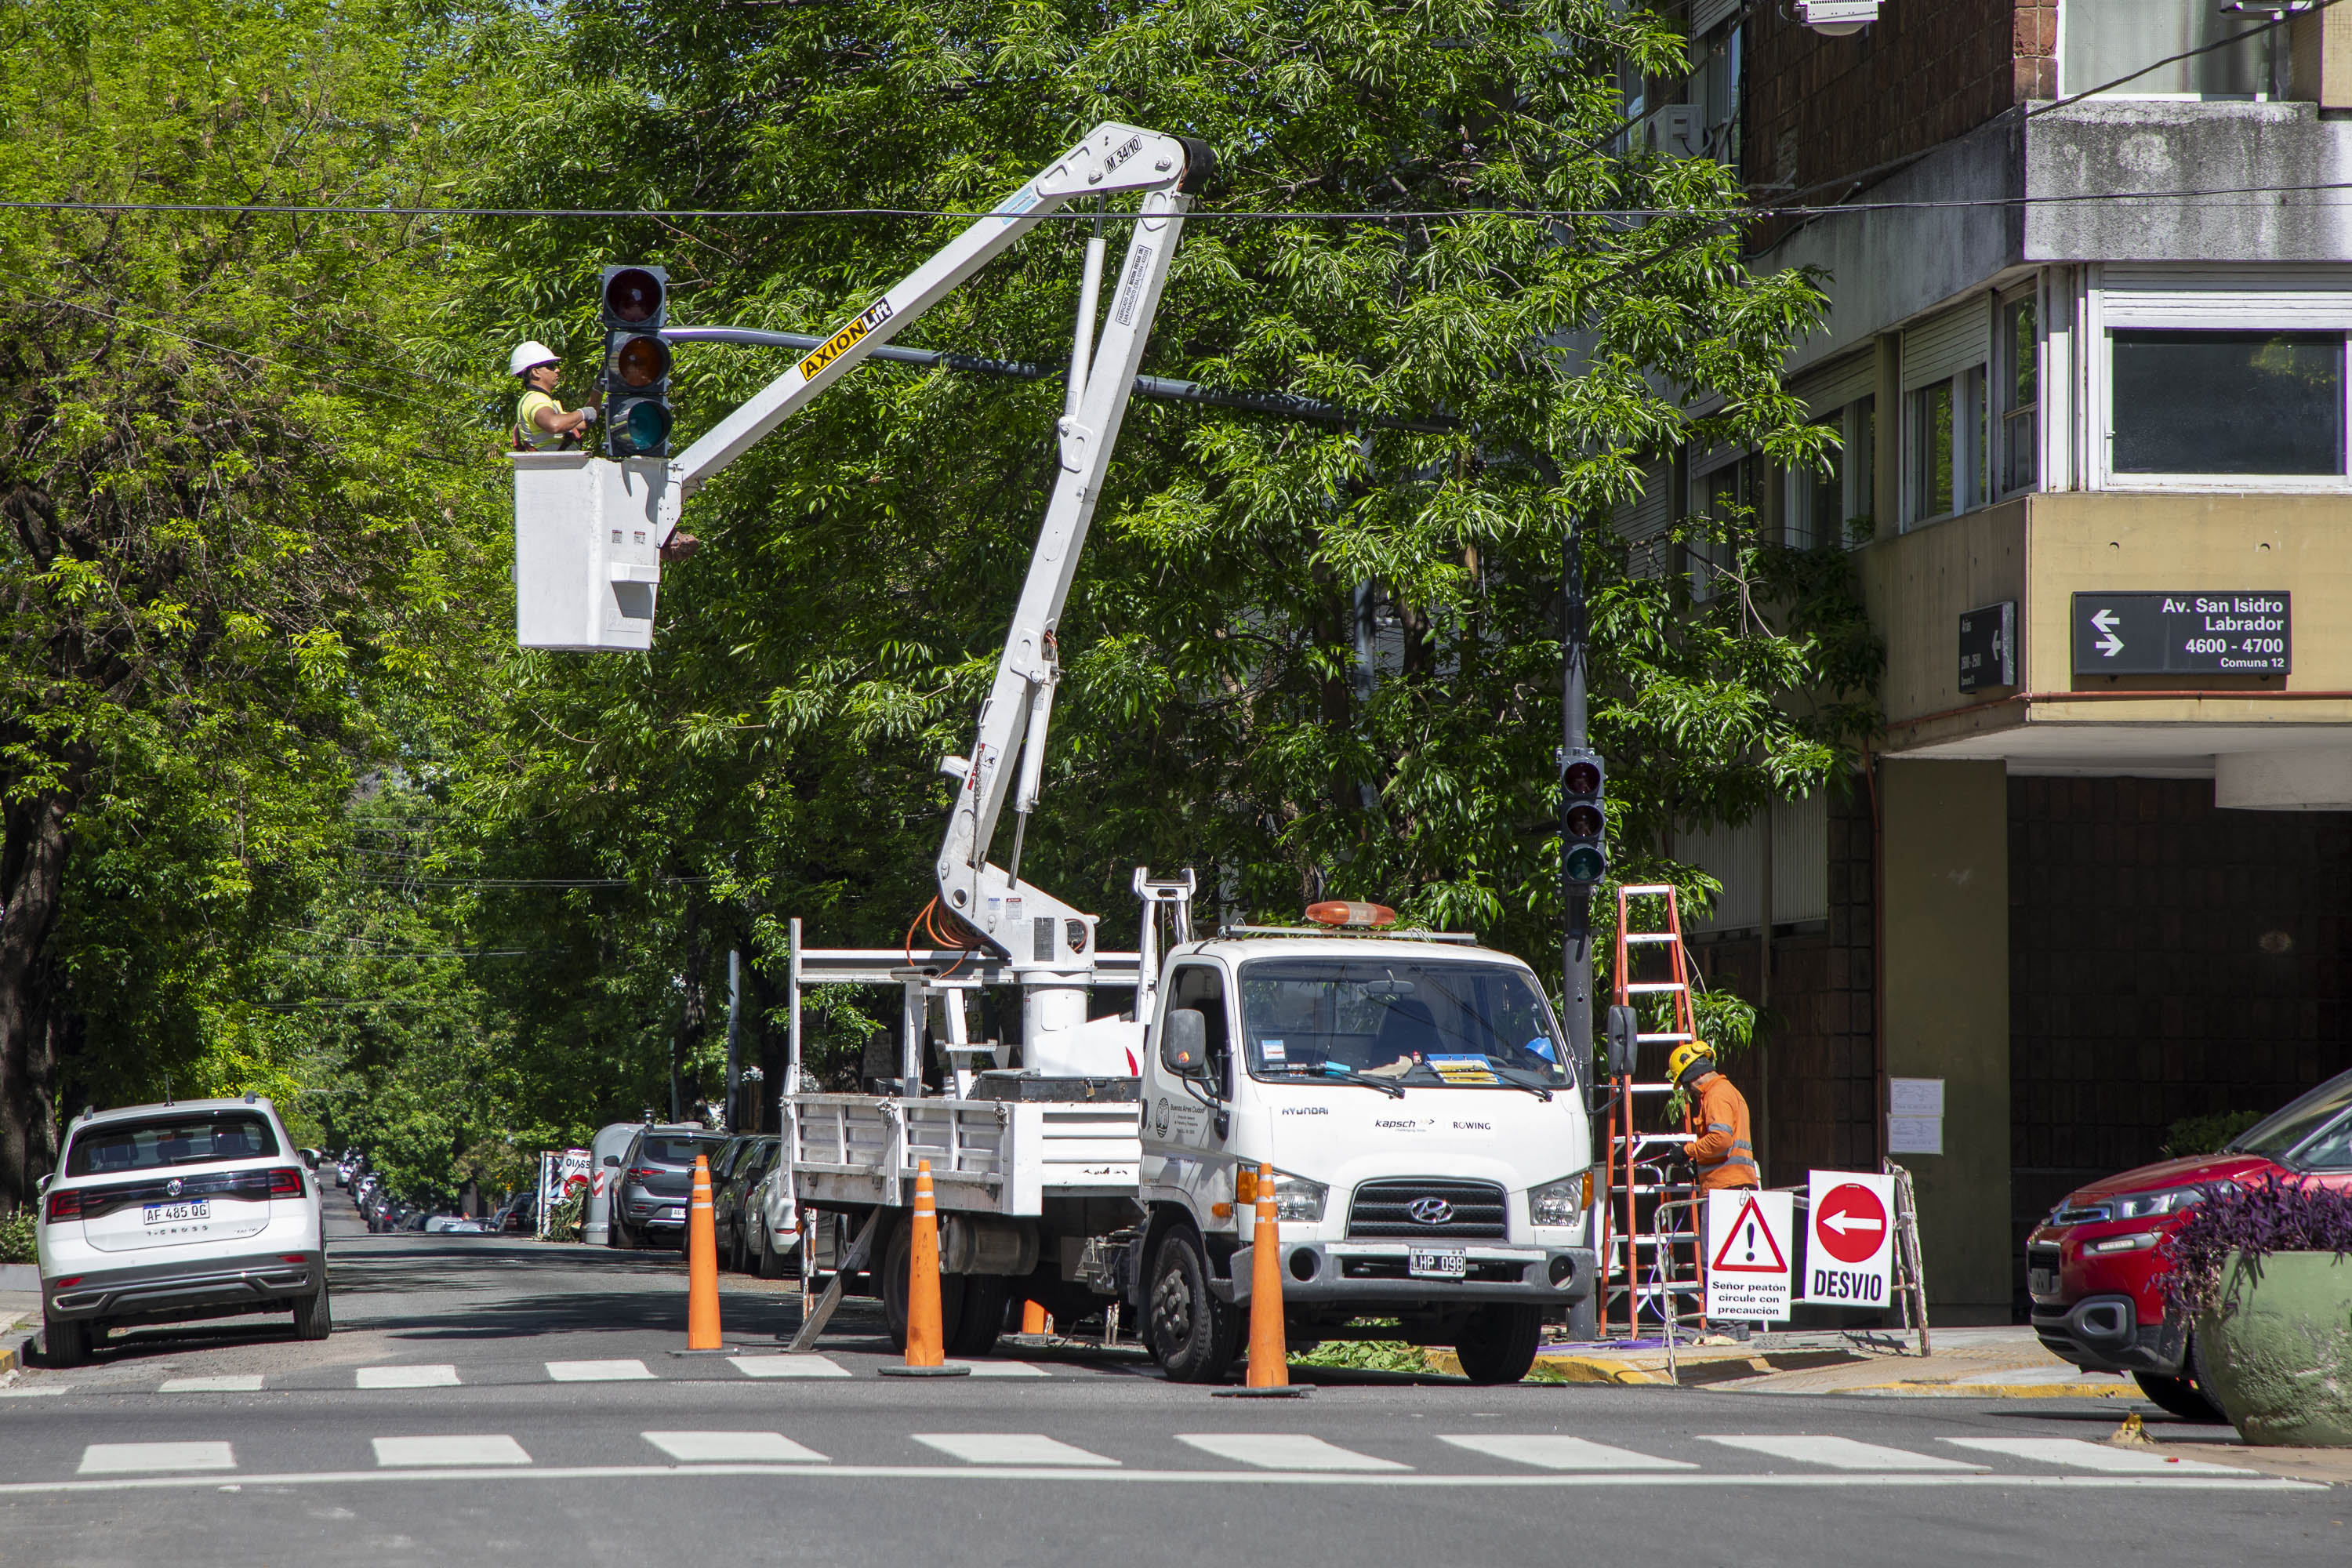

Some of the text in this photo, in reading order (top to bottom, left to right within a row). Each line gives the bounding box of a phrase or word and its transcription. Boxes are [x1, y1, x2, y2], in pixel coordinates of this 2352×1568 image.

[1107, 139, 1138, 171] M 34/10
[1118, 297, 1129, 321] FABRICADO
[1125, 290, 1136, 314] FRANCISCO
[2162, 598, 2283, 613] Av. San Isidro
[2205, 616, 2284, 630] Labrador
[2185, 639, 2227, 652] 4600
[2242, 639, 2283, 652] 4700
[2220, 658, 2285, 667] Comuna 12
[1375, 1120, 1416, 1128] kapsch
[1453, 1121, 1490, 1130] ROWING
[566, 1158, 590, 1168] ESVIO
[147, 1204, 206, 1221] AF 485 QG
[1413, 1254, 1464, 1271] LHP 098
[1712, 1281, 1786, 1292] Señor peatón
[1814, 1269, 1882, 1301] DESVIO
